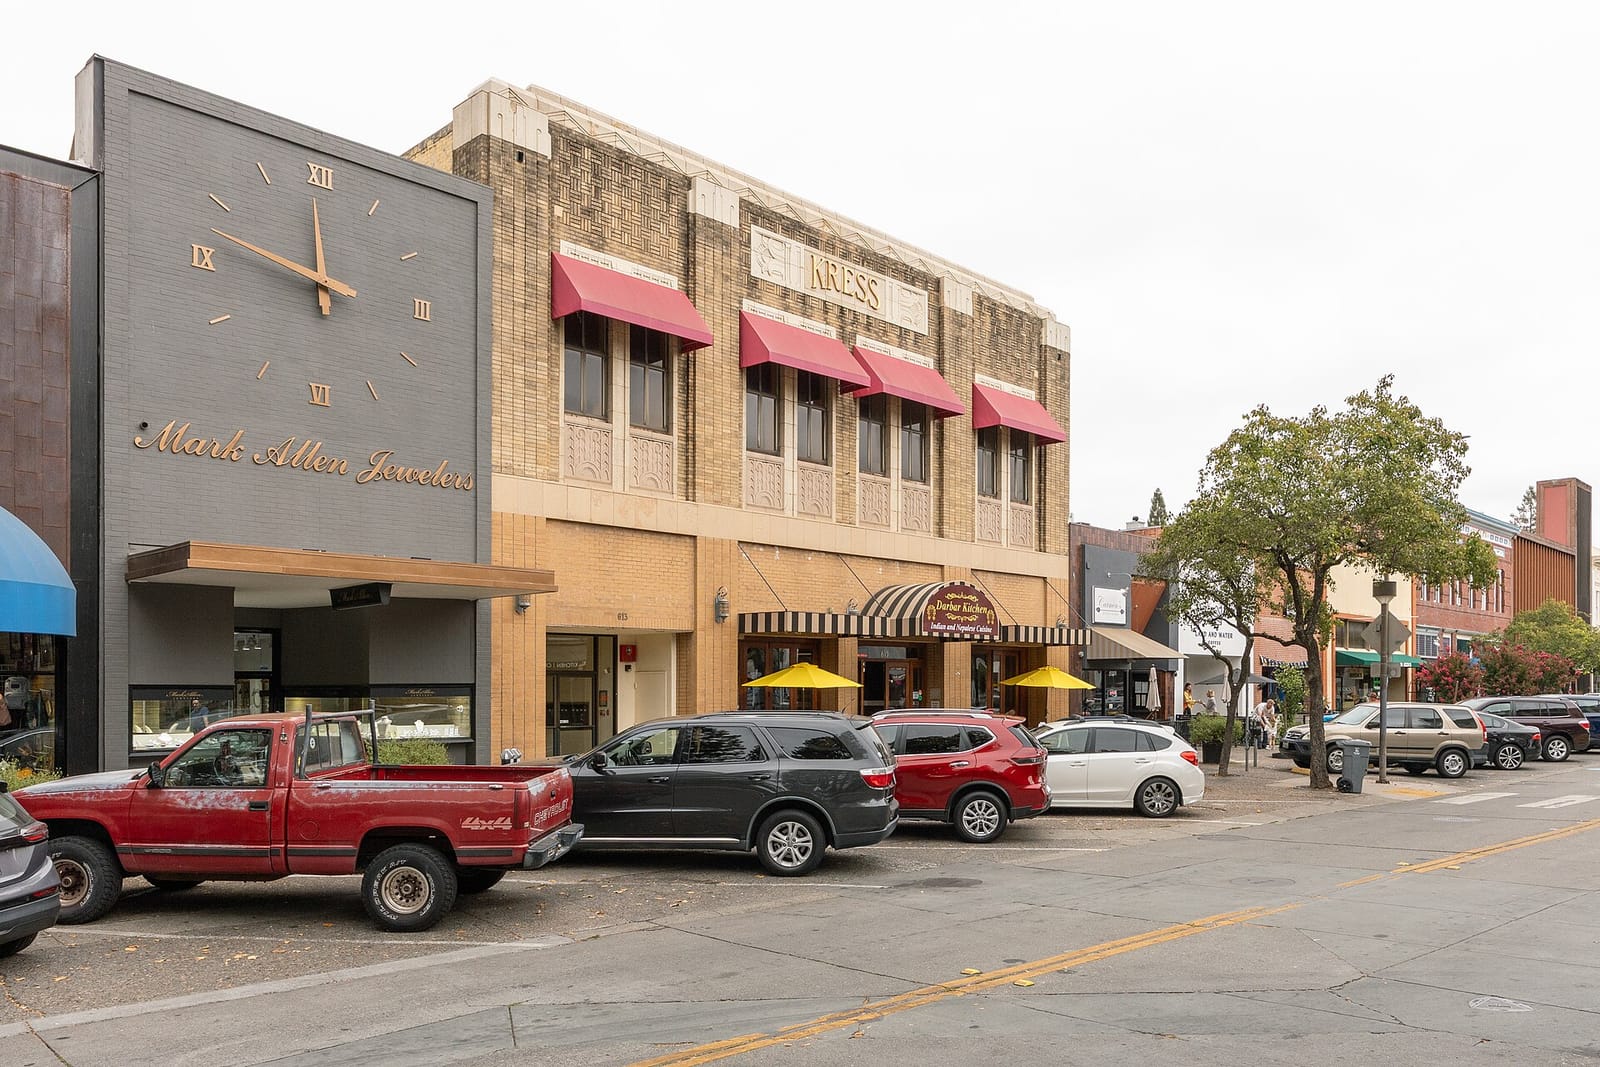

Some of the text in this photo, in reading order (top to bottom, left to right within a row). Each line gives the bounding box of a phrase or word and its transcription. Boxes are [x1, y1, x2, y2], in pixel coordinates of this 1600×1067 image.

[307, 162, 333, 190] XII
[191, 244, 216, 271] IX
[810, 254, 880, 311] KRESS
[414, 298, 432, 322] III
[309, 382, 331, 407] VI
[134, 419, 474, 491] Mark Allen Jewelers
[936, 600, 988, 614] Darbar Kitchen
[930, 622, 993, 633] Indian and Nepalese Cuisine
[533, 798, 569, 826] CHEVROLET
